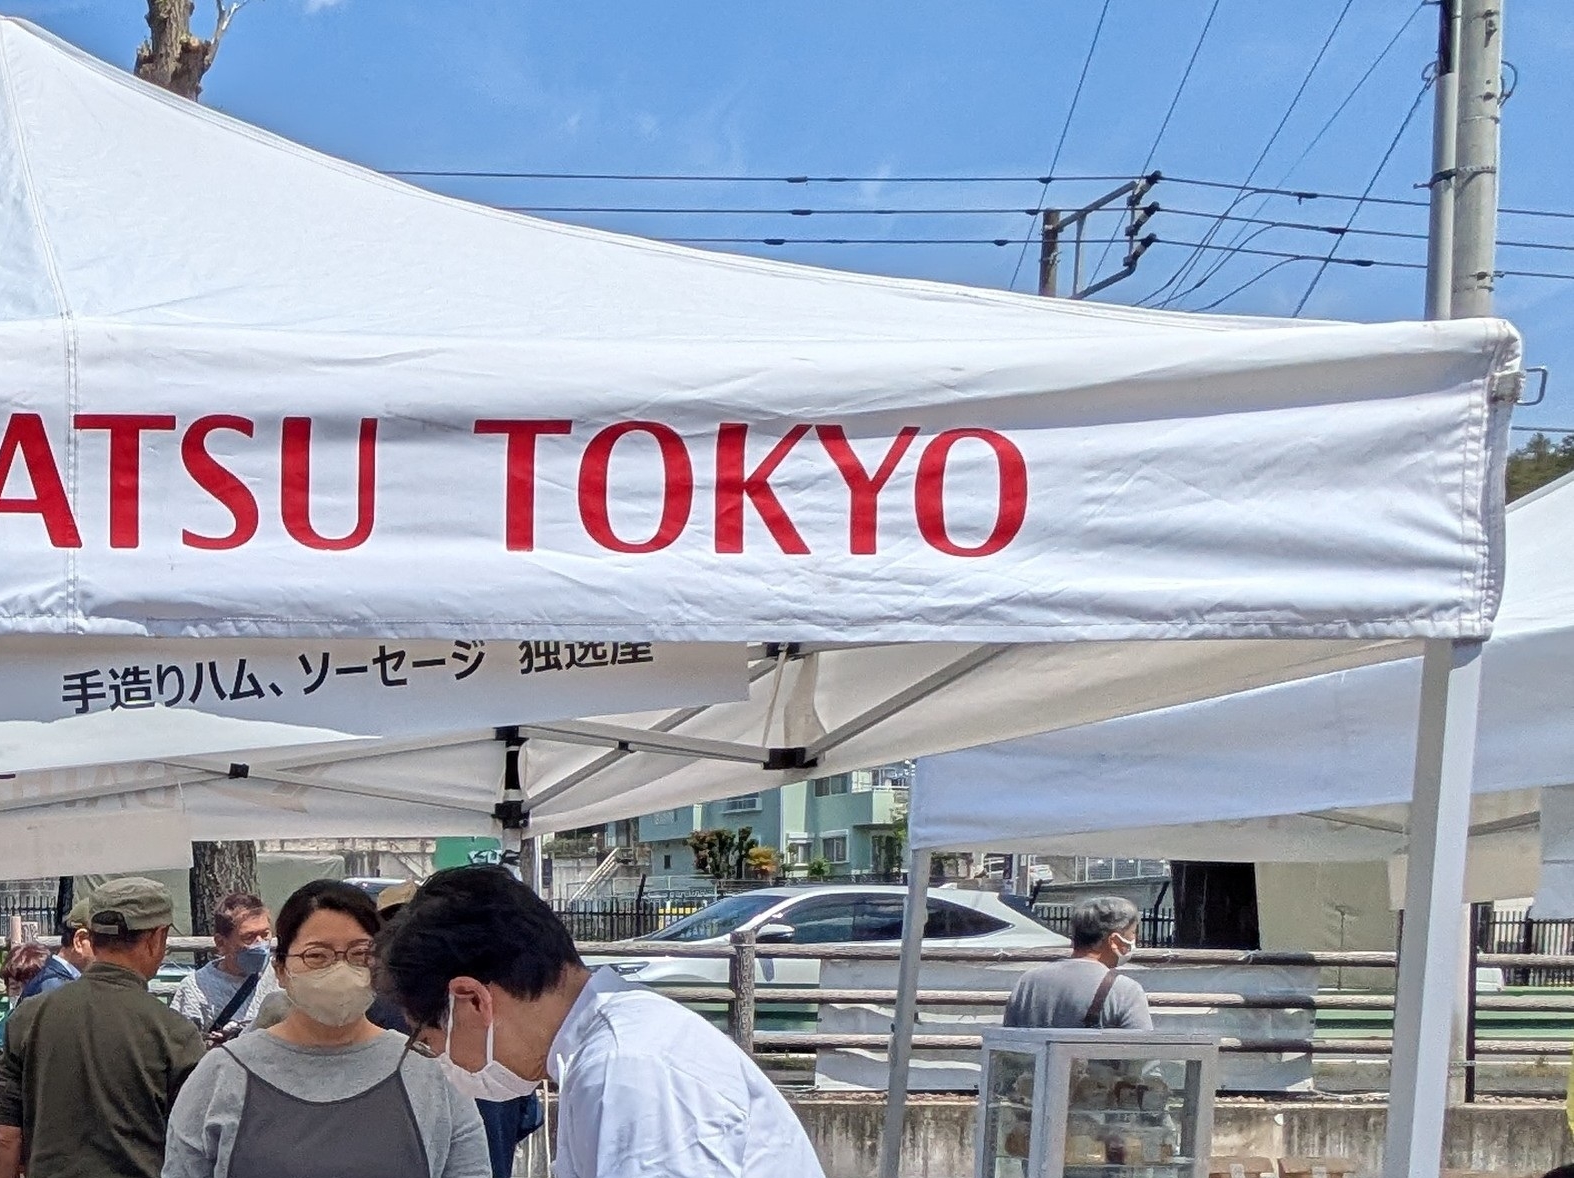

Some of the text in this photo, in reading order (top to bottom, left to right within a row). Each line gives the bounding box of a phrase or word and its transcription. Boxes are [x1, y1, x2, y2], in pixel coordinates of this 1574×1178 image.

[473, 419, 1027, 558] TOKYO
[60, 638, 487, 716] 手造りハム、ソーセージ
